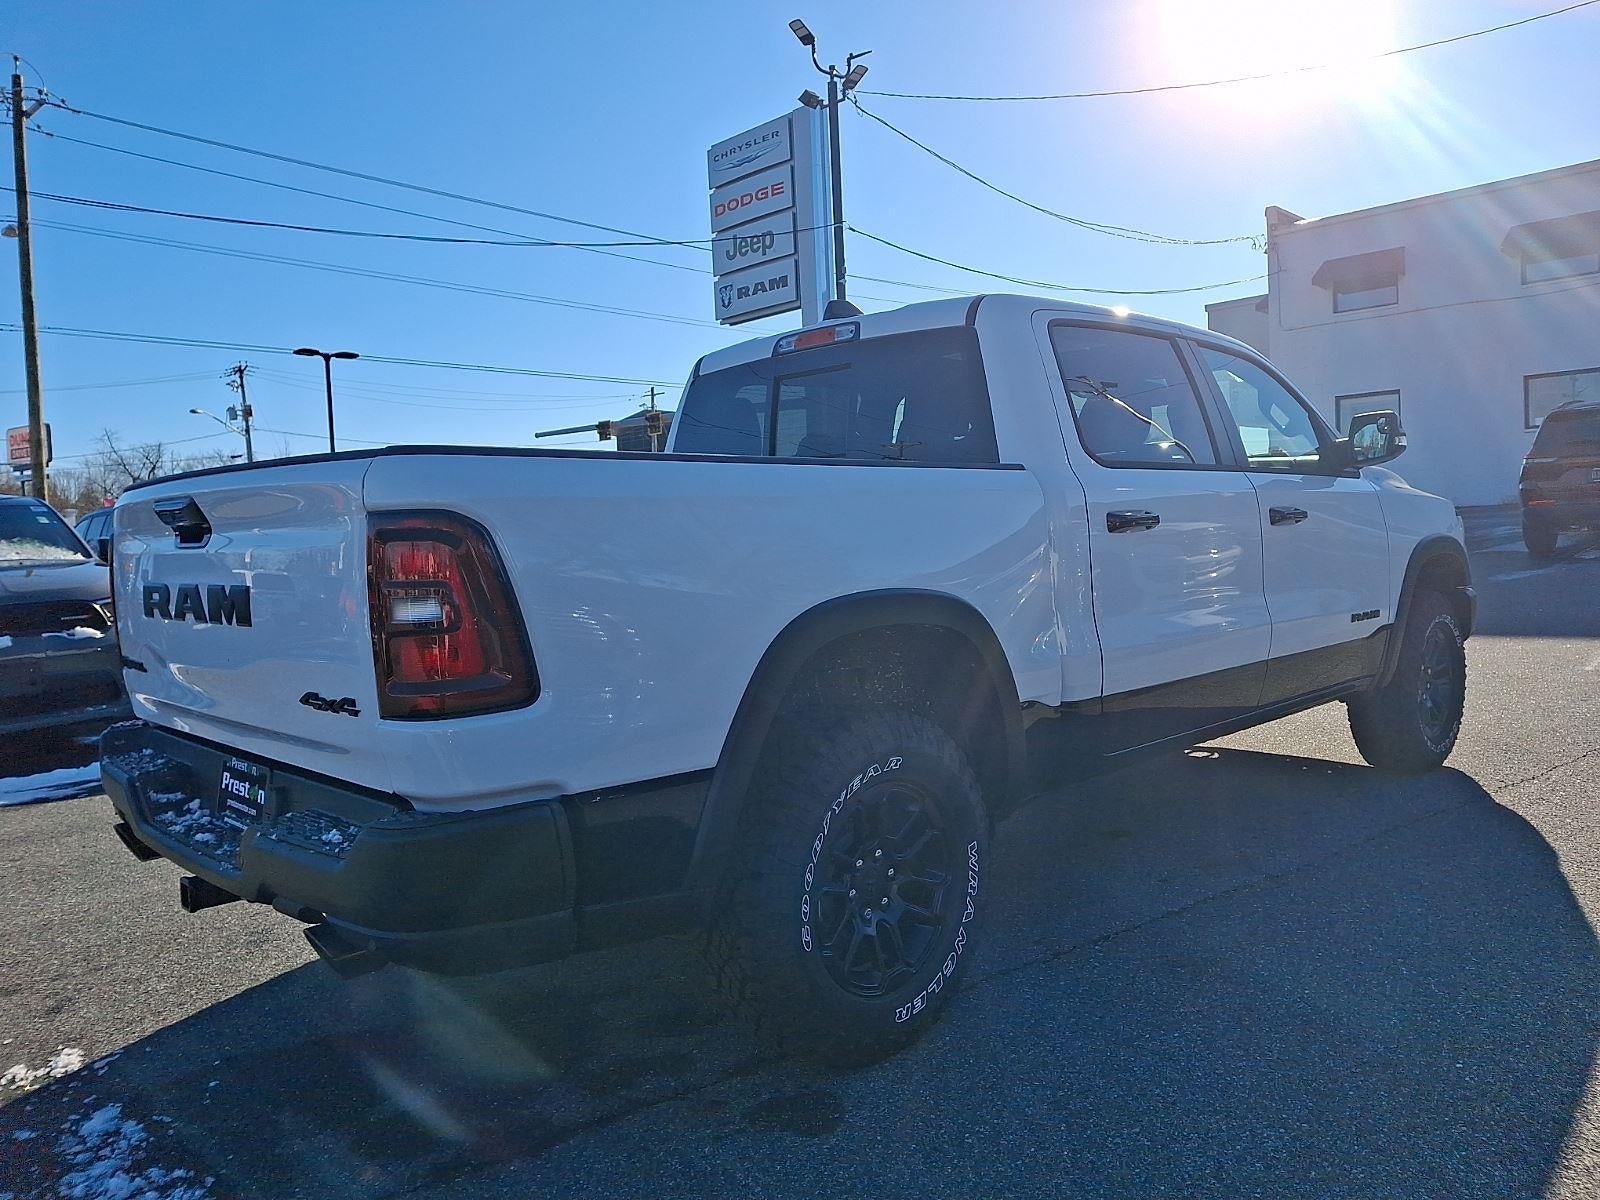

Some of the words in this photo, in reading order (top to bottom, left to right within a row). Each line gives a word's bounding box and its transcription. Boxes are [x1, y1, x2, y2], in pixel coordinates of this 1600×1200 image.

[713, 130, 780, 162] CHRYSLER
[714, 181, 785, 218] DODGE
[725, 229, 775, 261] Jeep
[737, 274, 789, 300] RAM
[142, 583, 253, 628] RAM
[1351, 609, 1381, 623] RAM
[801, 756, 903, 952] GOODYEAR
[895, 840, 979, 1023] WRANGLER
